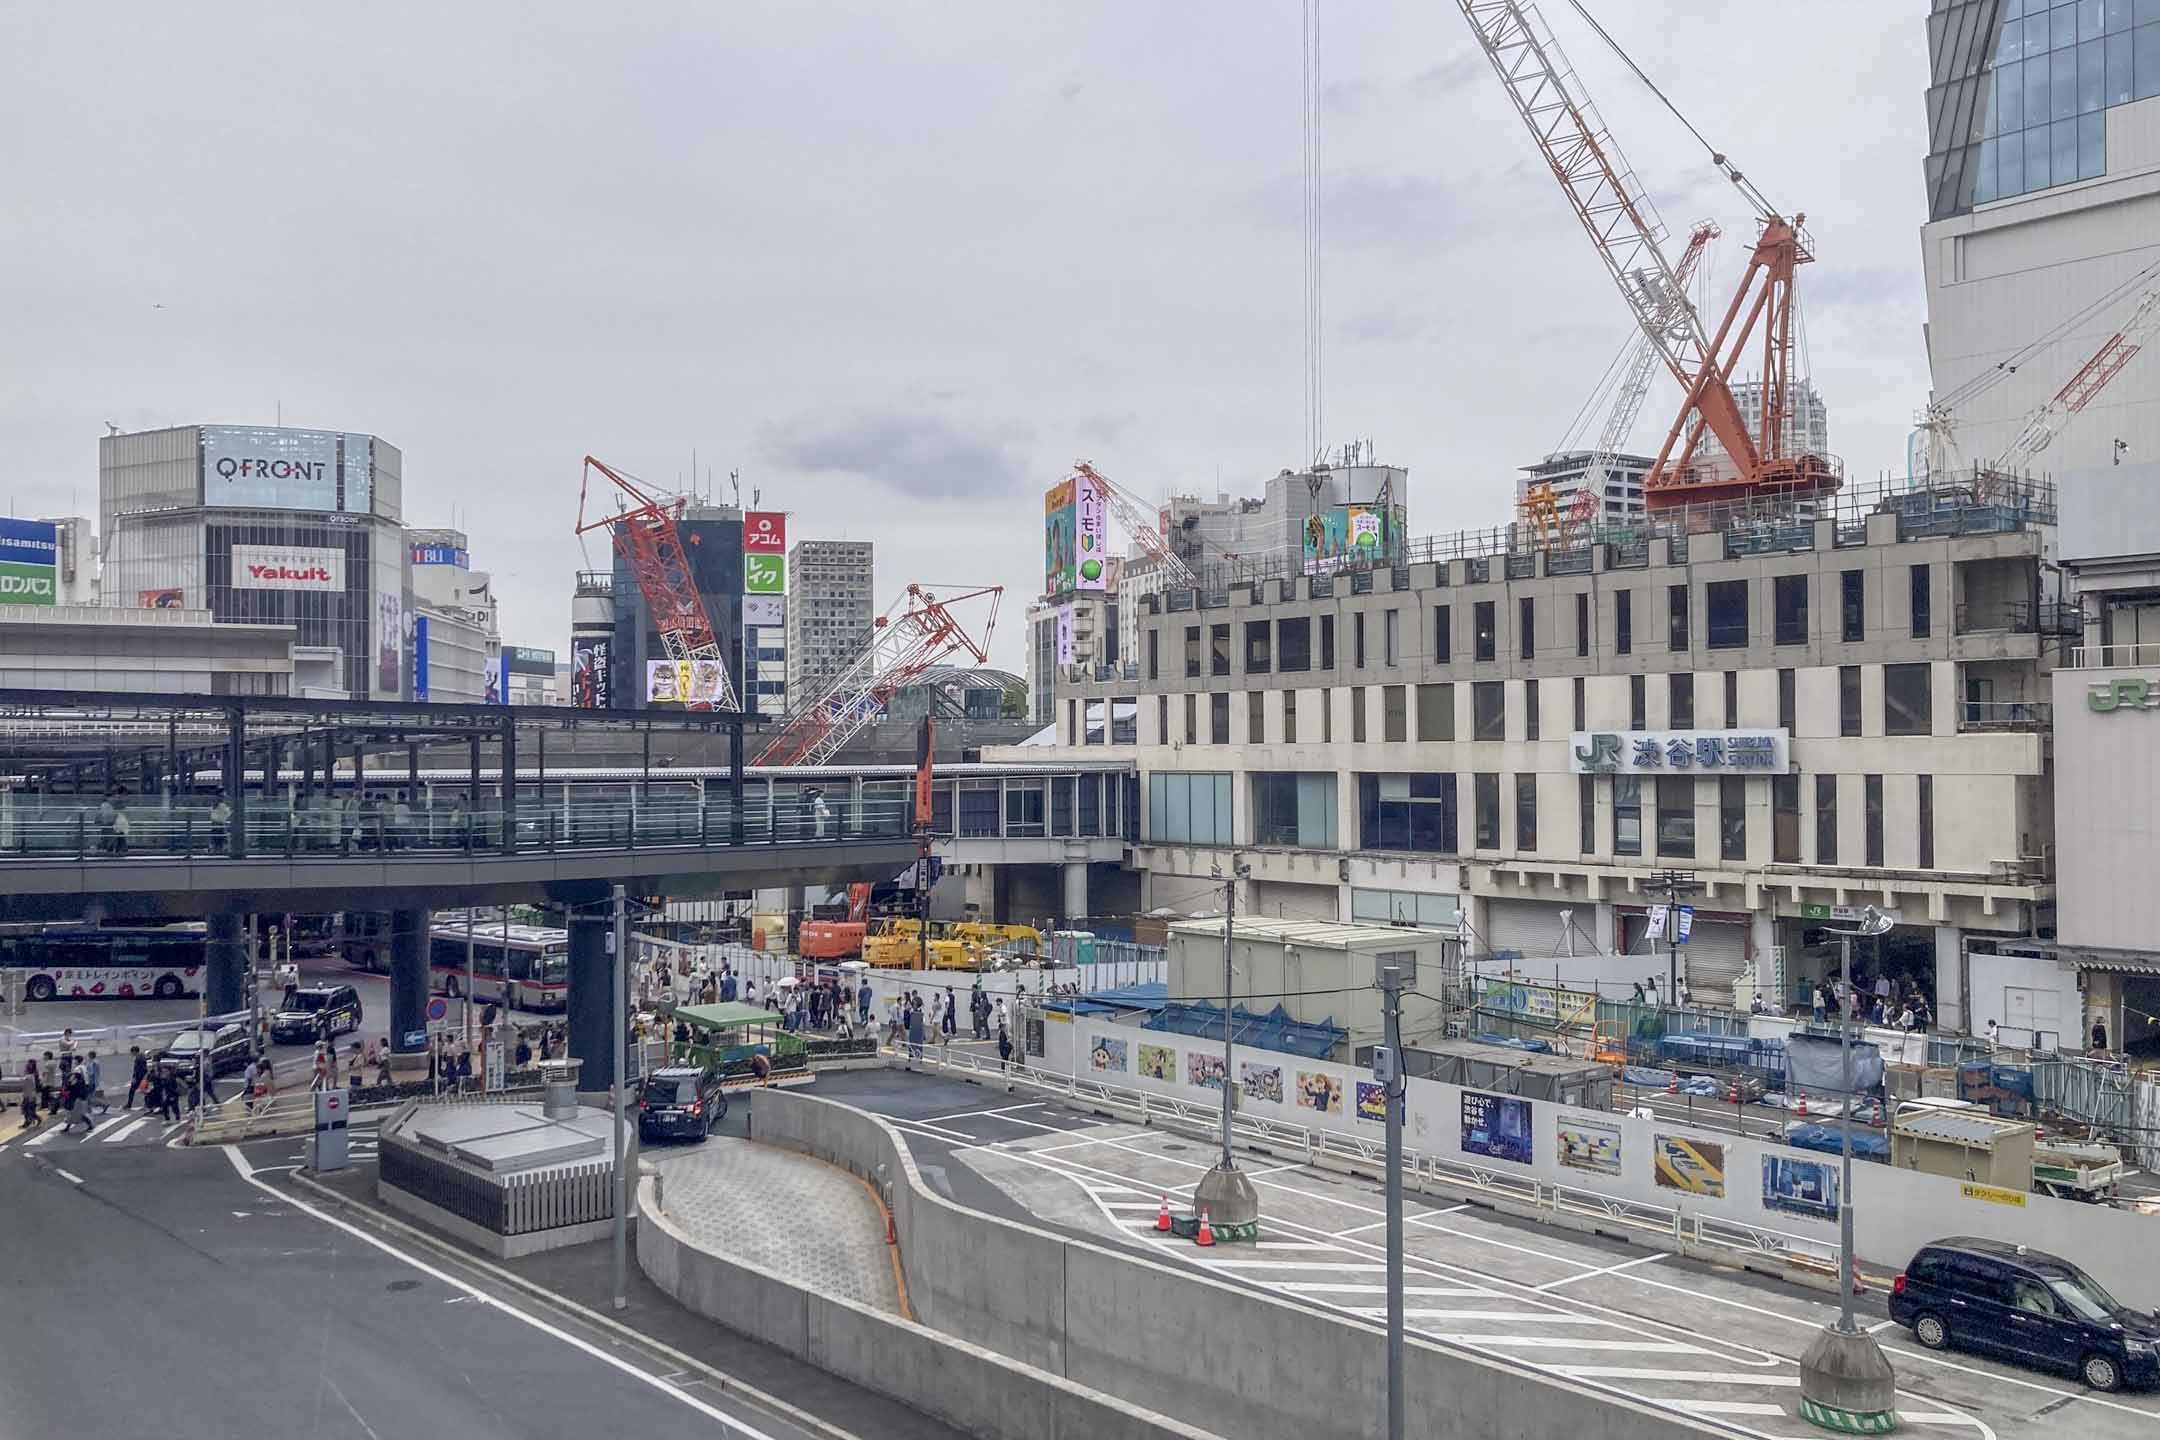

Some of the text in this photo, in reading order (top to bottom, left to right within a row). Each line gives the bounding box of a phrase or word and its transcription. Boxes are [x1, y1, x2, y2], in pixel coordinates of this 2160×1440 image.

[216, 457, 326, 483] QFRONT
[1081, 488, 1094, 532] スーモ
[0, 535, 56, 552] isamitsu
[748, 533, 781, 545] アコム
[248, 563, 332, 582] Yakult
[0, 575, 53, 597] ロンパス
[2088, 678, 2146, 712] JR
[1575, 733, 1726, 768] JR 渋谷駅
